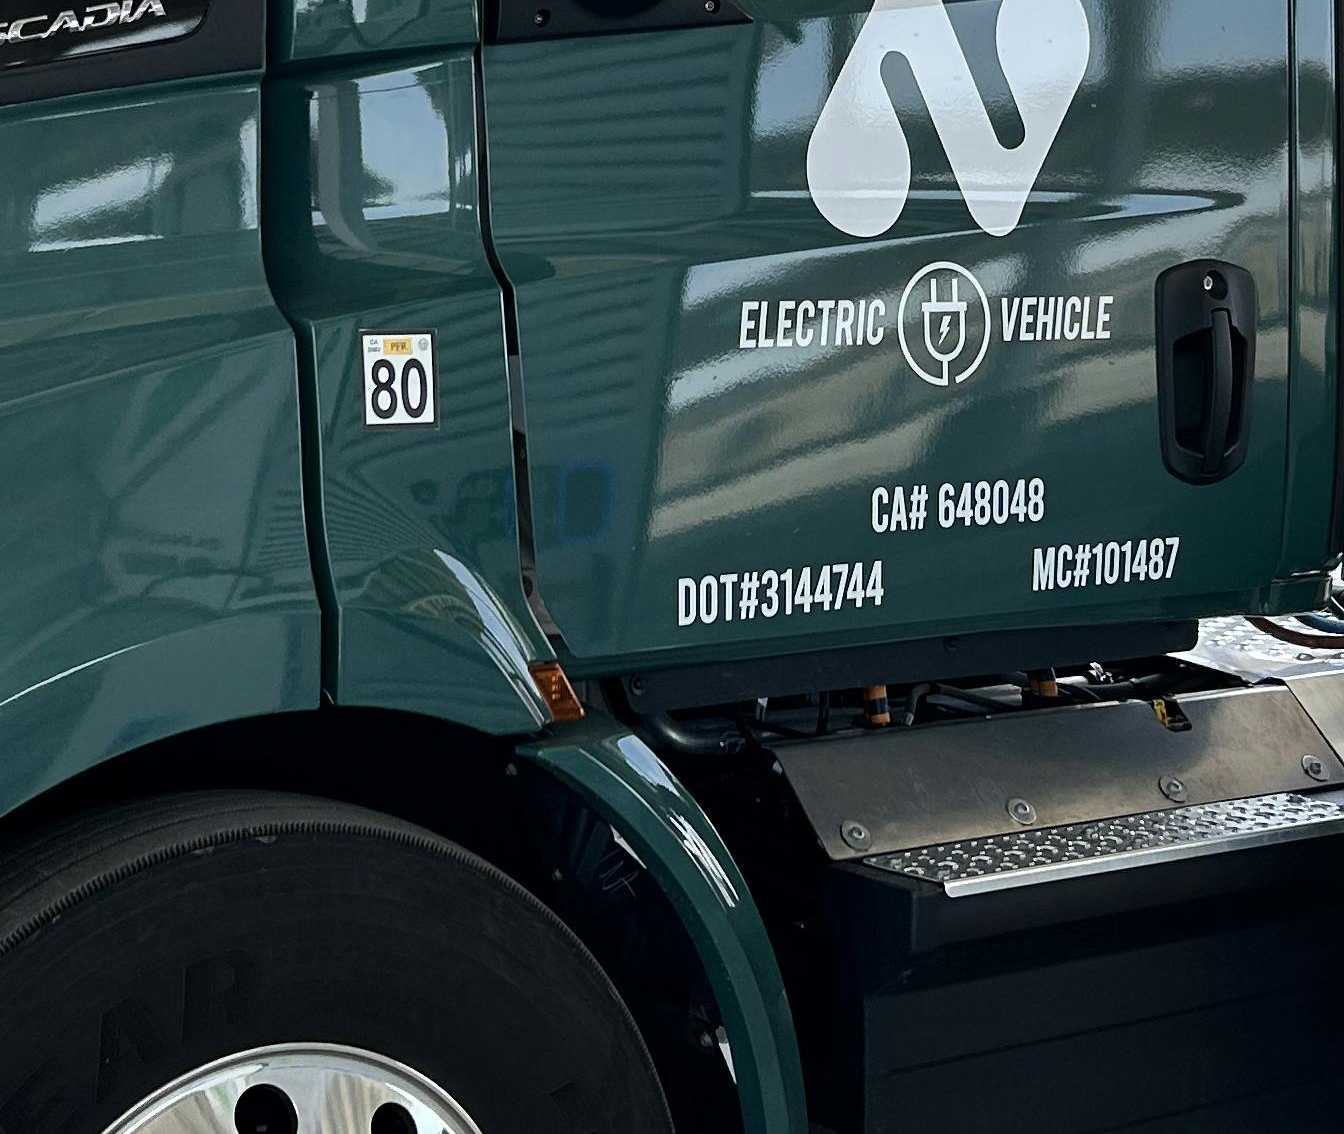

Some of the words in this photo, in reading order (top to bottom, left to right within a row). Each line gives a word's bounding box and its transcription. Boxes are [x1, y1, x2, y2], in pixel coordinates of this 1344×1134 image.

[739, 299, 886, 349] ELECTRIC
[1000, 295, 1114, 342] VEHICLE
[372, 358, 428, 419] 80
[871, 485, 928, 533] CA#
[938, 477, 1045, 528] 648048
[1032, 537, 1181, 592] MC#101487
[677, 560, 884, 626] DOT#3144744
